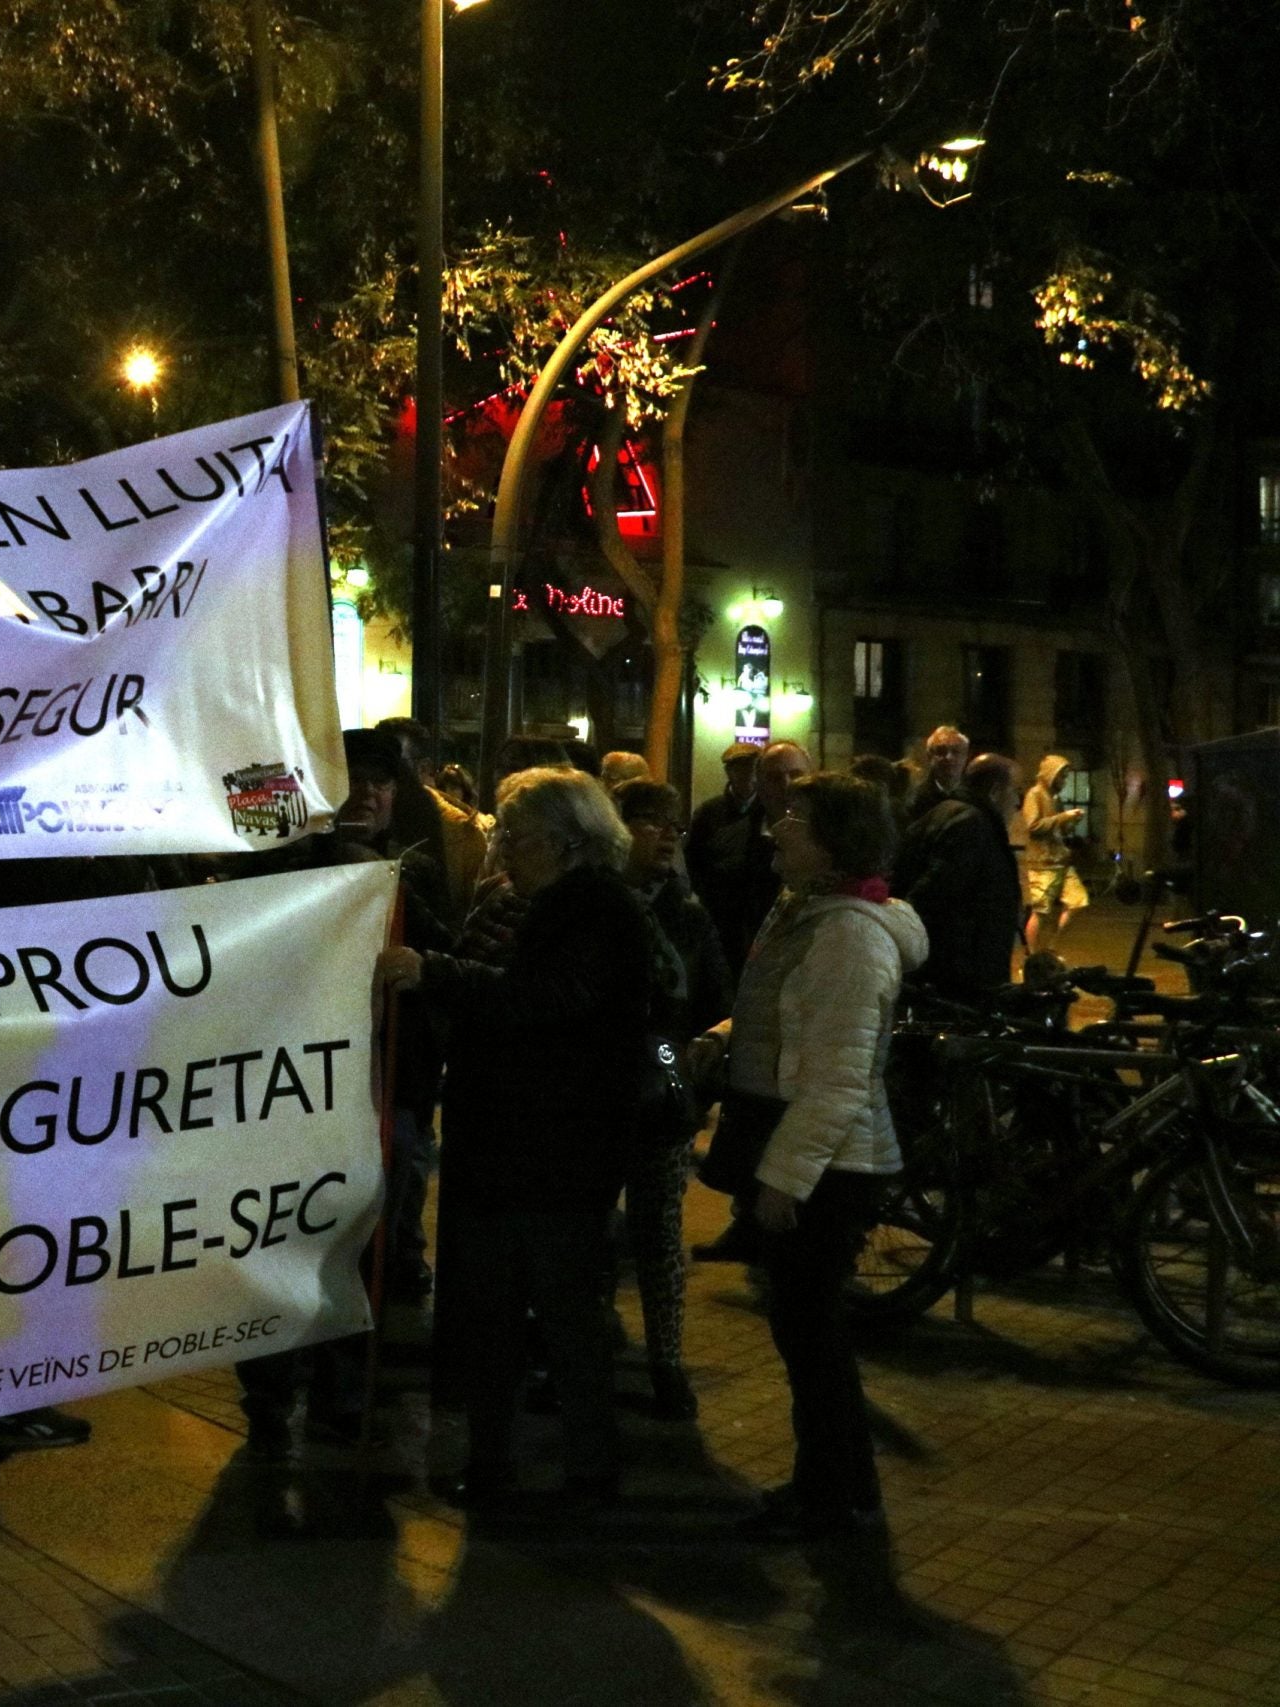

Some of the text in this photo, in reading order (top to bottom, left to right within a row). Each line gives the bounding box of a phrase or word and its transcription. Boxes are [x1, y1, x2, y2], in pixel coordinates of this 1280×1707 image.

[78, 434, 295, 532] LLUITA
[28, 558, 209, 636] BARRI
[9, 1354, 92, 1390] VEÏNS
[98, 1345, 138, 1373] DE
[143, 1315, 282, 1364] POBLE-SEC
